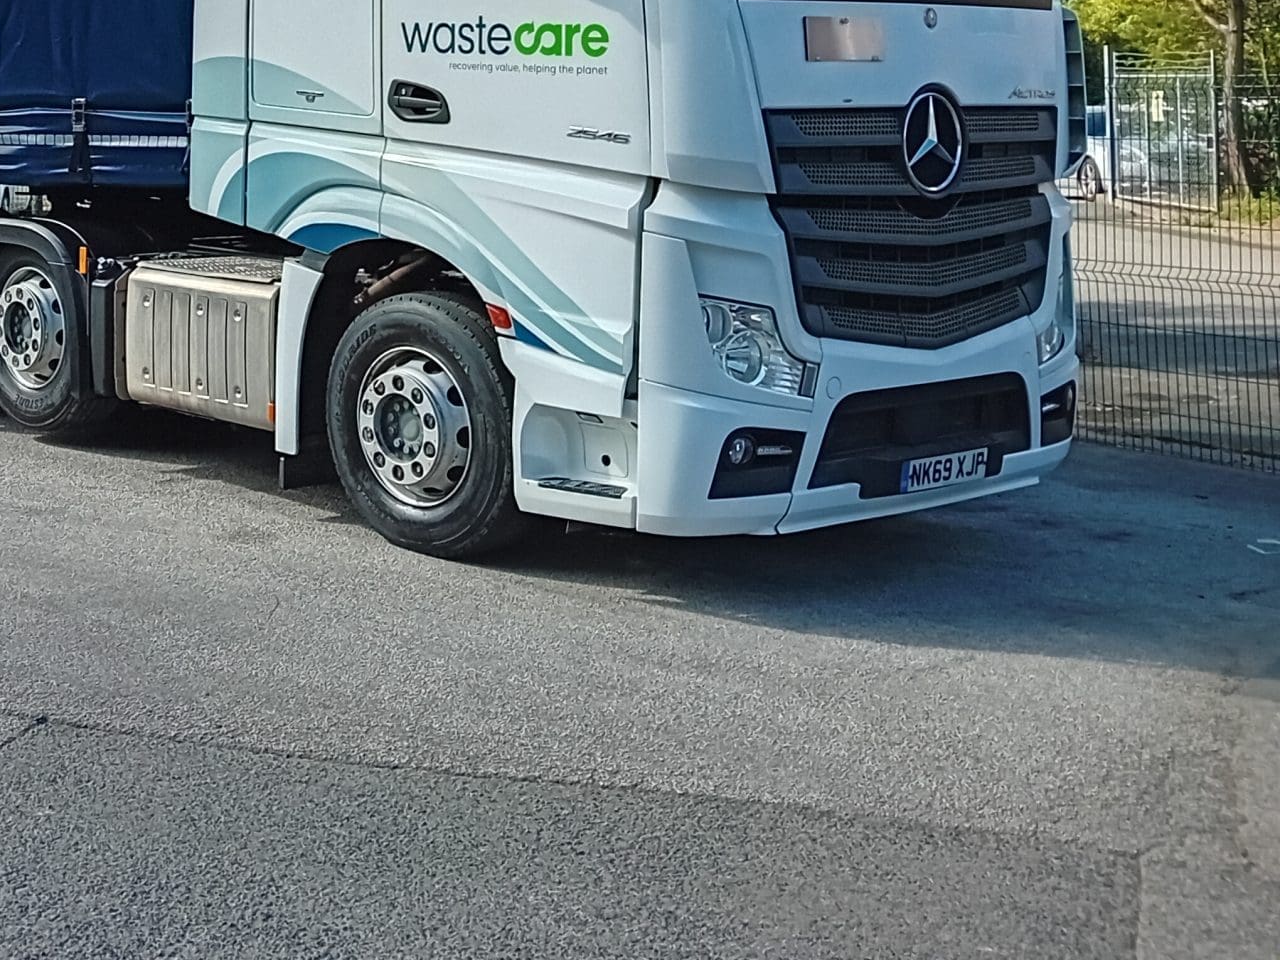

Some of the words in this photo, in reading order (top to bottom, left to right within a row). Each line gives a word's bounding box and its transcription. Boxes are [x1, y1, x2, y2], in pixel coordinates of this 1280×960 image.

[401, 15, 609, 57] wastecare
[448, 61, 493, 73] recovering
[495, 63, 520, 73] value,
[522, 63, 556, 76] helping
[558, 65, 574, 74] the
[576, 65, 608, 76] planet
[909, 457, 953, 488] NK69
